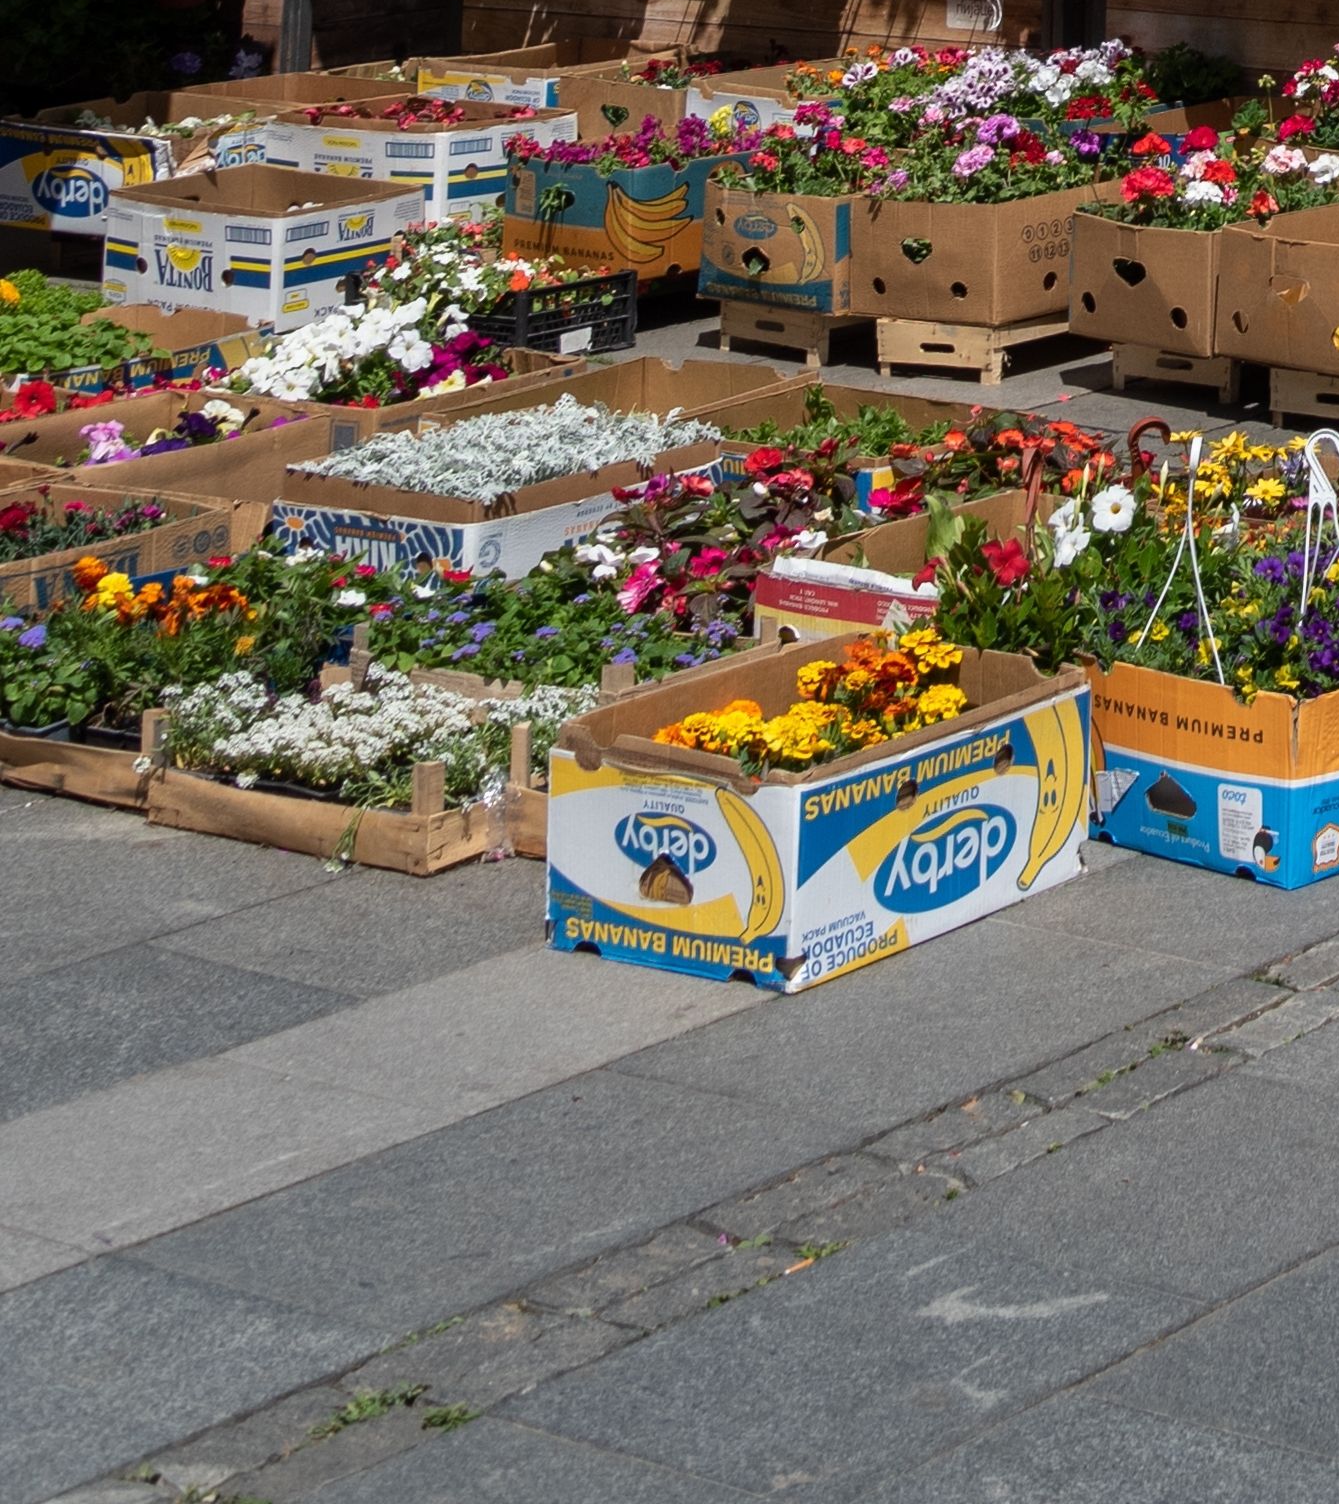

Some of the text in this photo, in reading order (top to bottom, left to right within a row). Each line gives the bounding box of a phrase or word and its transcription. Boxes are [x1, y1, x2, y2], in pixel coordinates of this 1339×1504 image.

[37, 171, 105, 216] derby
[338, 215, 375, 242] BONITA
[154, 249, 214, 293] BONITA
[563, 246, 614, 261] BANANAS
[1093, 694, 1264, 745] PREMIUM BANANAS
[803, 729, 1011, 821] PREMIUM BANANAS
[642, 800, 686, 815] QUALITY
[921, 786, 980, 818] QUALITY
[1221, 790, 1247, 806] toco
[621, 814, 709, 876] derby
[883, 815, 1007, 897] derby
[565, 917, 775, 973] PREMIUM BANANAS
[801, 910, 866, 942] VACUUM PACK
[801, 920, 874, 960] ECUADOR
[800, 929, 898, 981] PRODUCE OF
